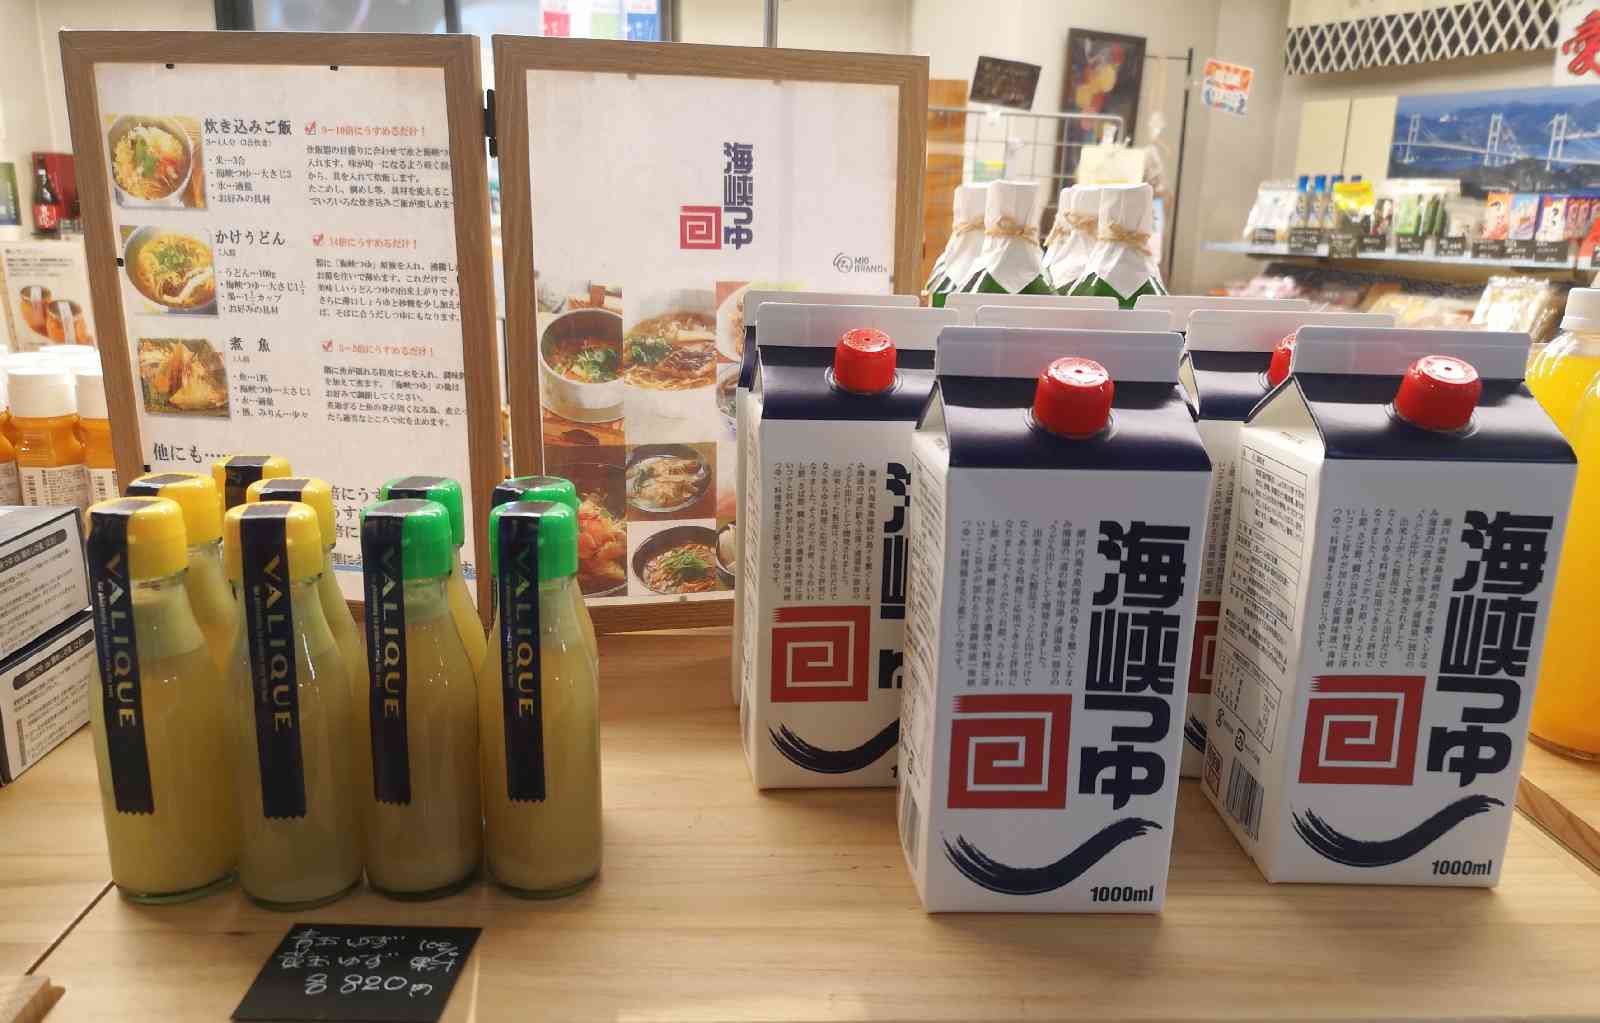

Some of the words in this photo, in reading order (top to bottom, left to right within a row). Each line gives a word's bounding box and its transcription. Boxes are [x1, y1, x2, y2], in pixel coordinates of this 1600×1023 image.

[204, 118, 292, 136] 炊き込みご飯
[723, 142, 753, 250] 海峡つゆ
[215, 230, 286, 247] かけうどん
[229, 336, 244, 351] 煮
[258, 337, 271, 352] 魚
[105, 553, 136, 729] VALIQUE
[264, 554, 292, 733] VALIQUE
[381, 546, 400, 719] VALIQUE
[515, 546, 533, 718] VALIQUE
[1078, 520, 1190, 810] 海峡つゆ
[1426, 510, 1554, 788] 海峡つゆ
[1090, 885, 1154, 903] 1000ml
[1431, 859, 1493, 877] 1000ml
